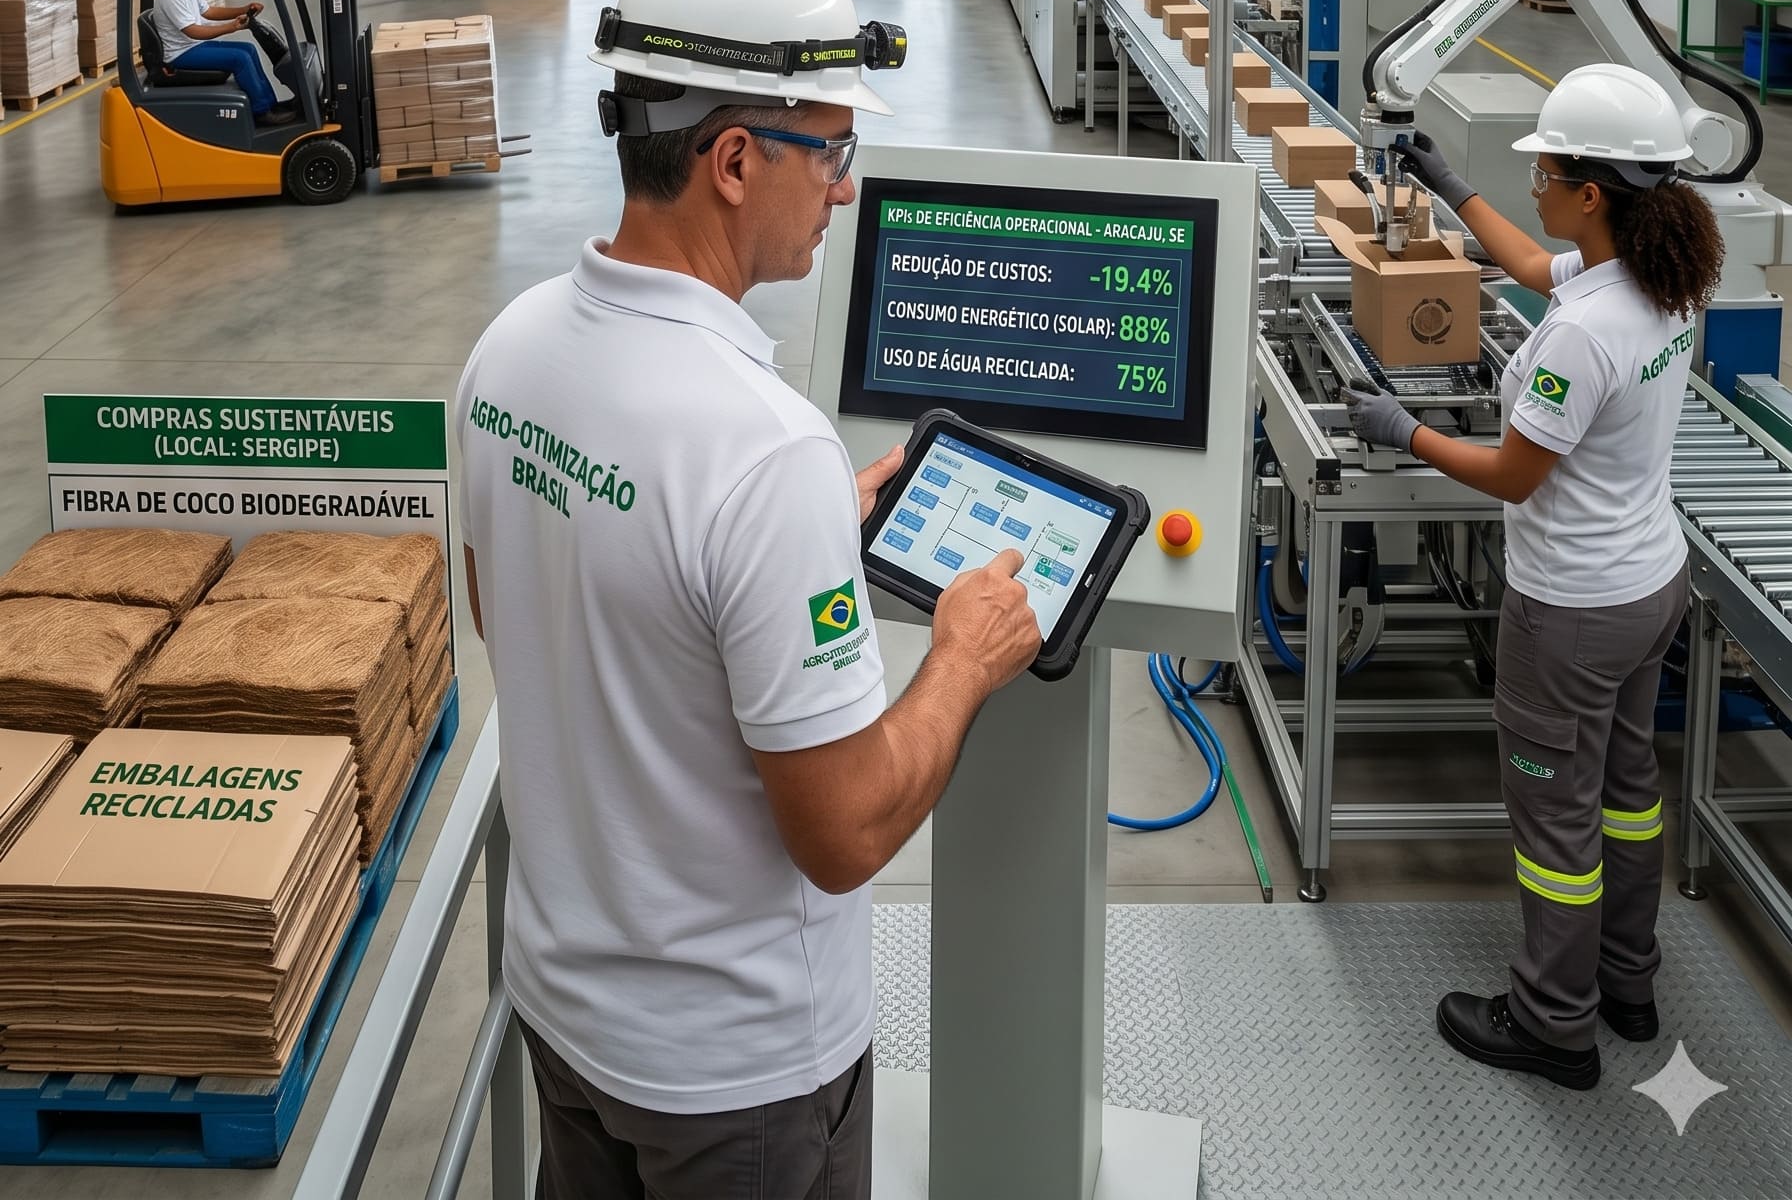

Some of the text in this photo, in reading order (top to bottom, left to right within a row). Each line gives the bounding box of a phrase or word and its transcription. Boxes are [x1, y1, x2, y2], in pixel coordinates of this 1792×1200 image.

[887, 207, 912, 224] KPIs
[916, 211, 932, 225] DE
[935, 210, 1002, 230] EFICIÊNCIA
[1005, 217, 1093, 237] OPERACIONAL
[1104, 224, 1166, 243] ARACAJU,
[1169, 228, 1185, 243] SE
[891, 254, 1172, 296] REDUÇÃO DE CUSTOS: -19.4%
[887, 301, 1170, 345] CONSUMO ENERGÉTICO (SOLAR): 88%
[884, 347, 1167, 394] USO DE ÁGUA RECICLADA: 75%
[97, 403, 394, 433] COMPRAS SUSTENTÁVEIS
[154, 436, 340, 461] (LOCAL: SERGIPE)
[470, 396, 636, 512] AGRO-OTIMIZAÇÃO
[62, 489, 434, 518] FIBRA DE COCO BIODEGRADÁVEL
[512, 456, 571, 519] BRASIL
[89, 761, 303, 792] EMBALAGENS
[79, 793, 278, 823] RECICLADAS
